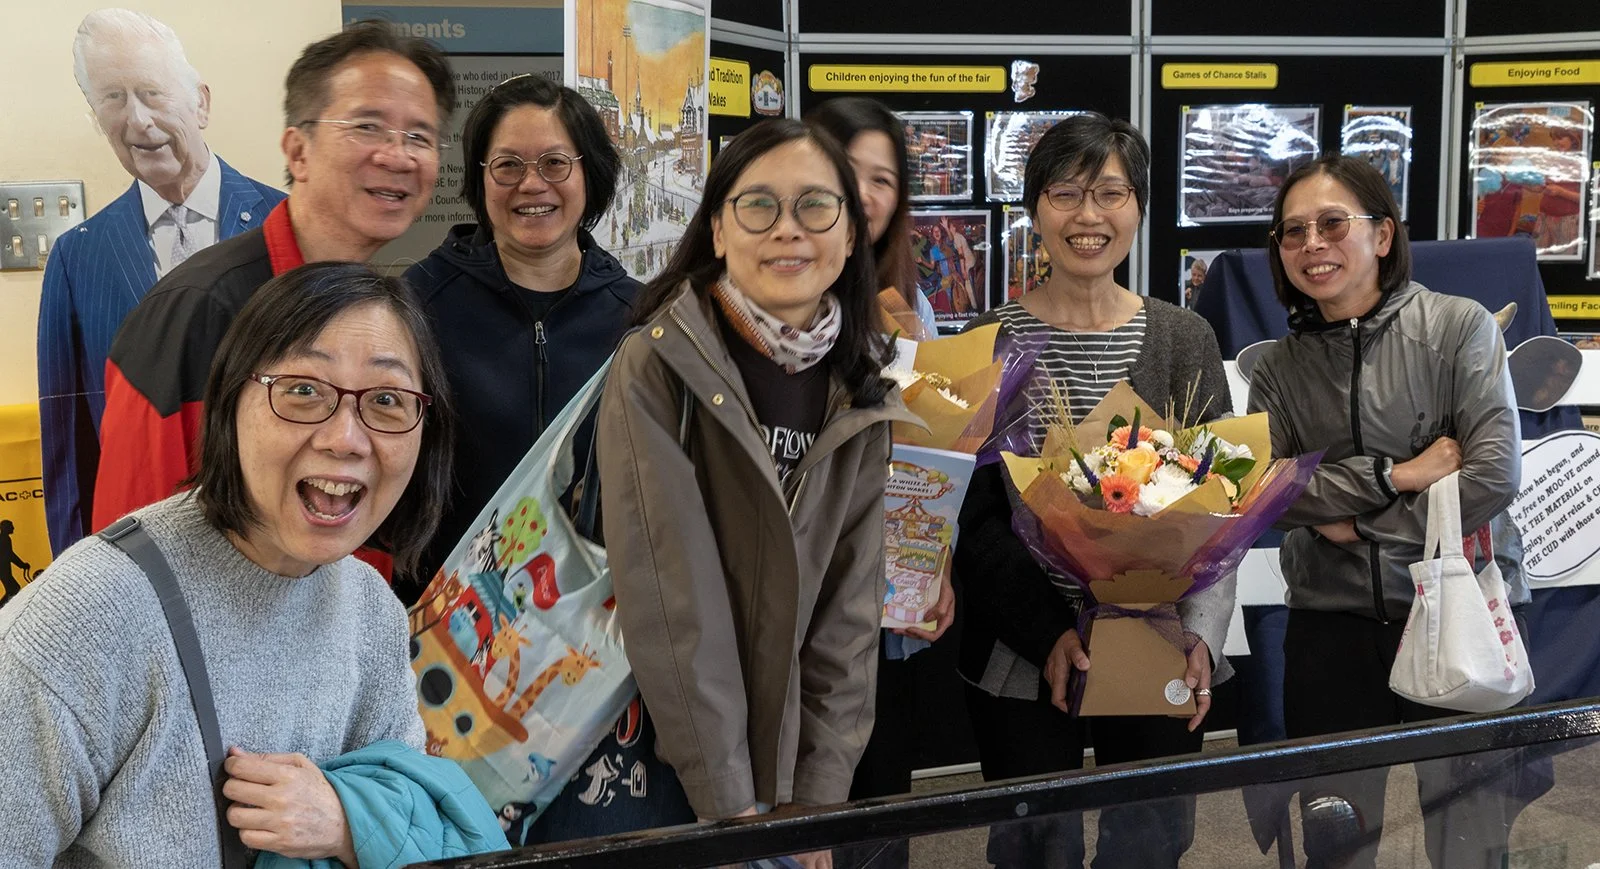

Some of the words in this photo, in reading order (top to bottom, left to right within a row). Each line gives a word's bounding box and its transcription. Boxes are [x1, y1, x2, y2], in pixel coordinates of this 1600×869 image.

[463, 70, 479, 80] who
[484, 70, 498, 80] died
[716, 68, 743, 84] Tradition
[825, 71, 866, 82] Children
[868, 72, 909, 84] enjoying
[912, 73, 927, 83] the
[930, 73, 945, 83] fun
[947, 73, 956, 83] of
[958, 73, 973, 83] the
[975, 73, 990, 83] fair
[1173, 70, 1200, 79] Games
[1203, 70, 1211, 79] of
[1213, 70, 1243, 79] Chance
[1245, 70, 1267, 79] Stalls
[1508, 68, 1551, 78] Enjoying
[1554, 67, 1580, 77] Food
[458, 84, 486, 97] History
[447, 177, 458, 187] for
[425, 213, 445, 222] more
[1549, 301, 1578, 311] miling
[1533, 474, 1547, 487] has
[1546, 458, 1571, 477] begun,
[1570, 443, 1584, 458] and
[1522, 501, 1537, 518] free
[1537, 494, 1545, 503] to
[1545, 468, 1575, 497] MOO-VE
[1576, 449, 1600, 473] around
[1528, 512, 1545, 529] THE
[1545, 482, 1583, 516] MATERIAL
[1583, 476, 1594, 486] on
[1545, 525, 1553, 536] or
[1553, 514, 1568, 532] just
[1567, 500, 1586, 517] relax
[1586, 493, 1593, 503] &
[1525, 553, 1542, 570] THE
[1541, 540, 1559, 557] CUD
[1559, 527, 1576, 543] with
[1575, 513, 1595, 530] those
